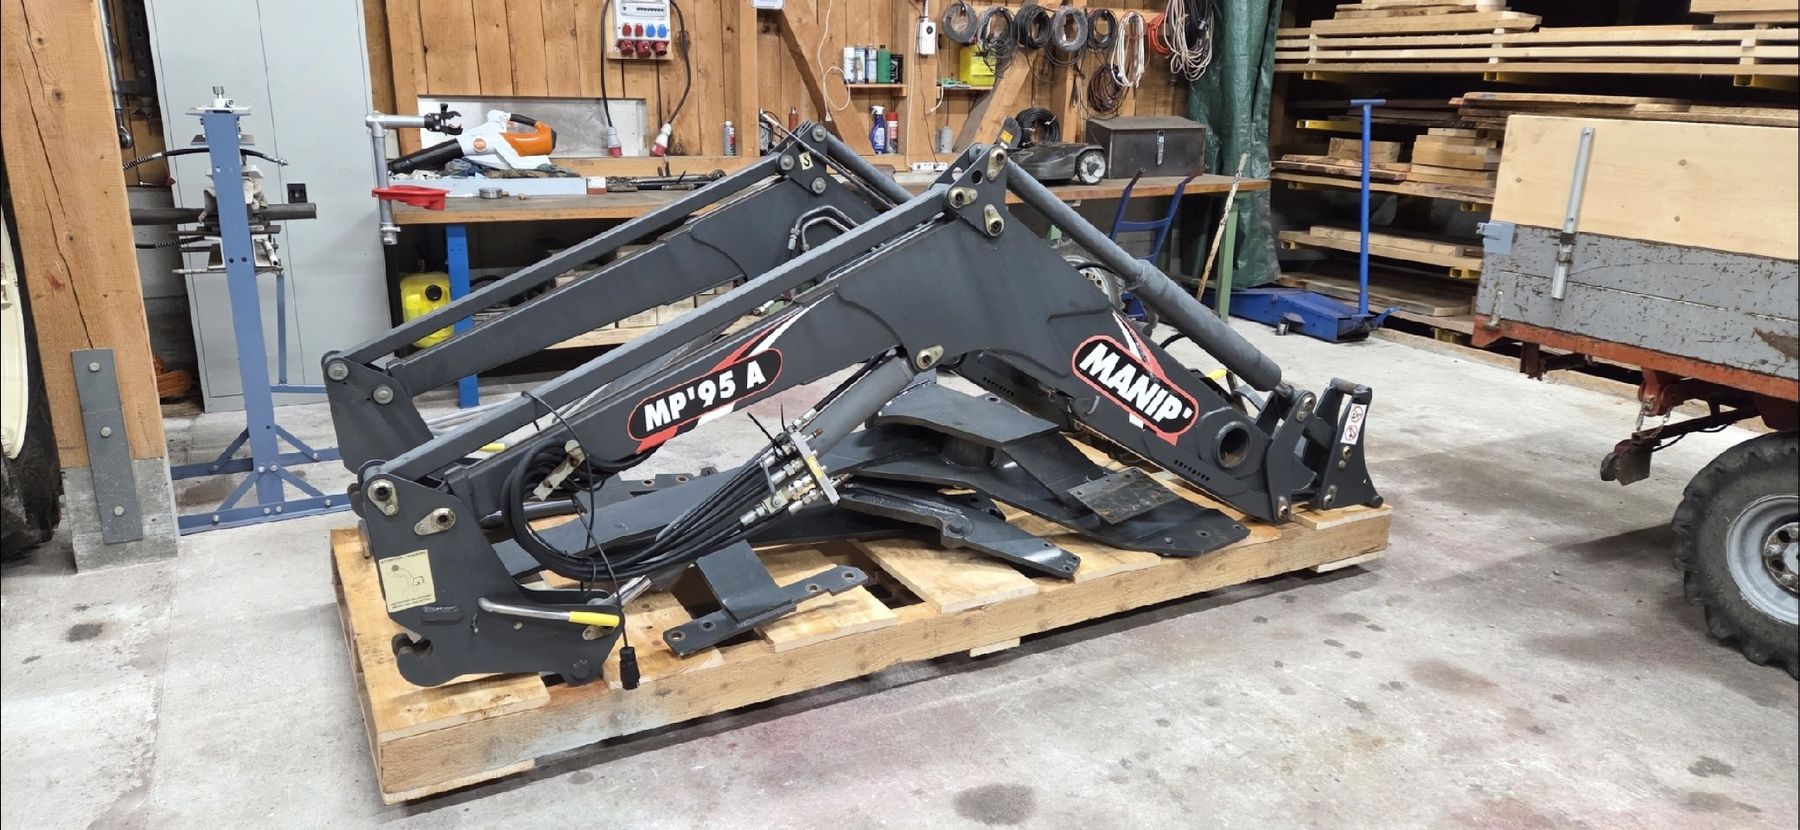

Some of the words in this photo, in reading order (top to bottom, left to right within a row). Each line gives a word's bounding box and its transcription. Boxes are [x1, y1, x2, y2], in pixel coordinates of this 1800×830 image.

[644, 370, 736, 432] MP'95
[746, 360, 767, 389] A
[1079, 342, 1194, 422] MANIP'
